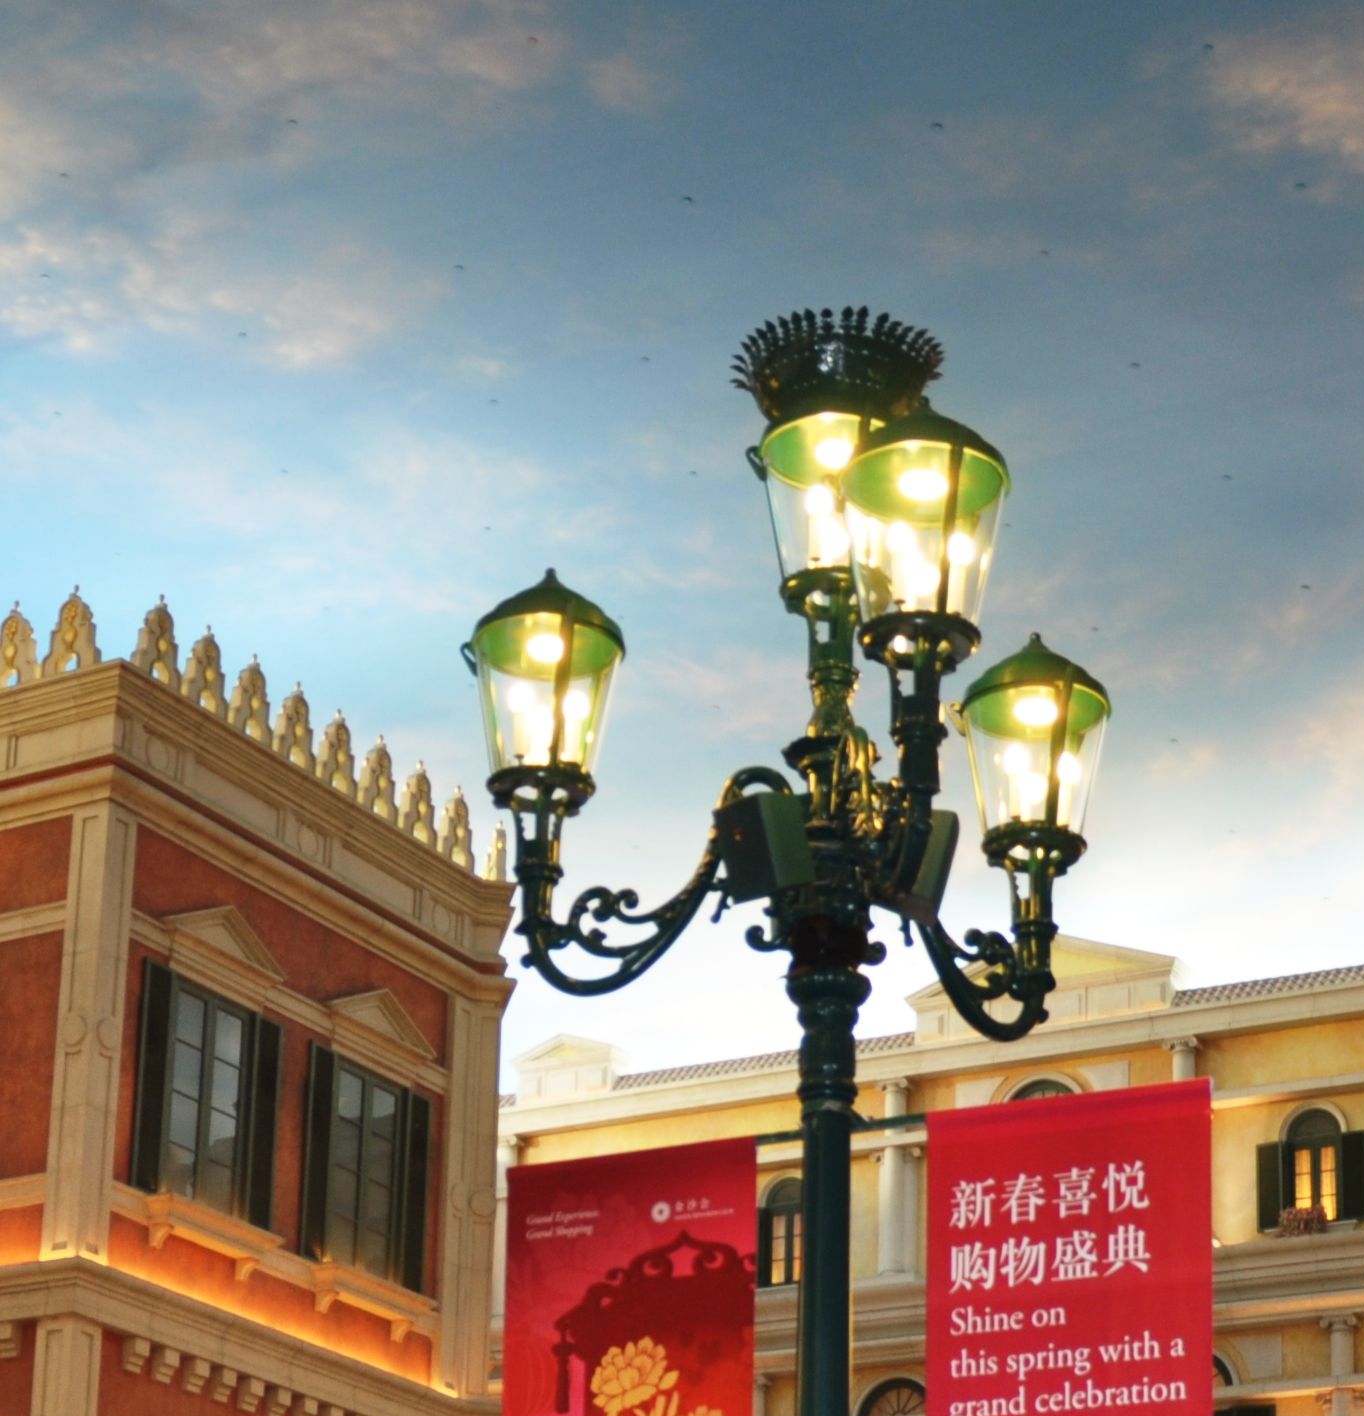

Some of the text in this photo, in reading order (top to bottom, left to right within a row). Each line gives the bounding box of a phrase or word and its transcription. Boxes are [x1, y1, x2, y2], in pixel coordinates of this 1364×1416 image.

[949, 1160, 1150, 1229] 新春喜悦
[949, 1223, 1151, 1294] 购物盛典
[950, 1306, 1066, 1336] Shine on
[950, 1330, 1186, 1381] this spring with a
[1035, 1376, 1188, 1413] celebration
